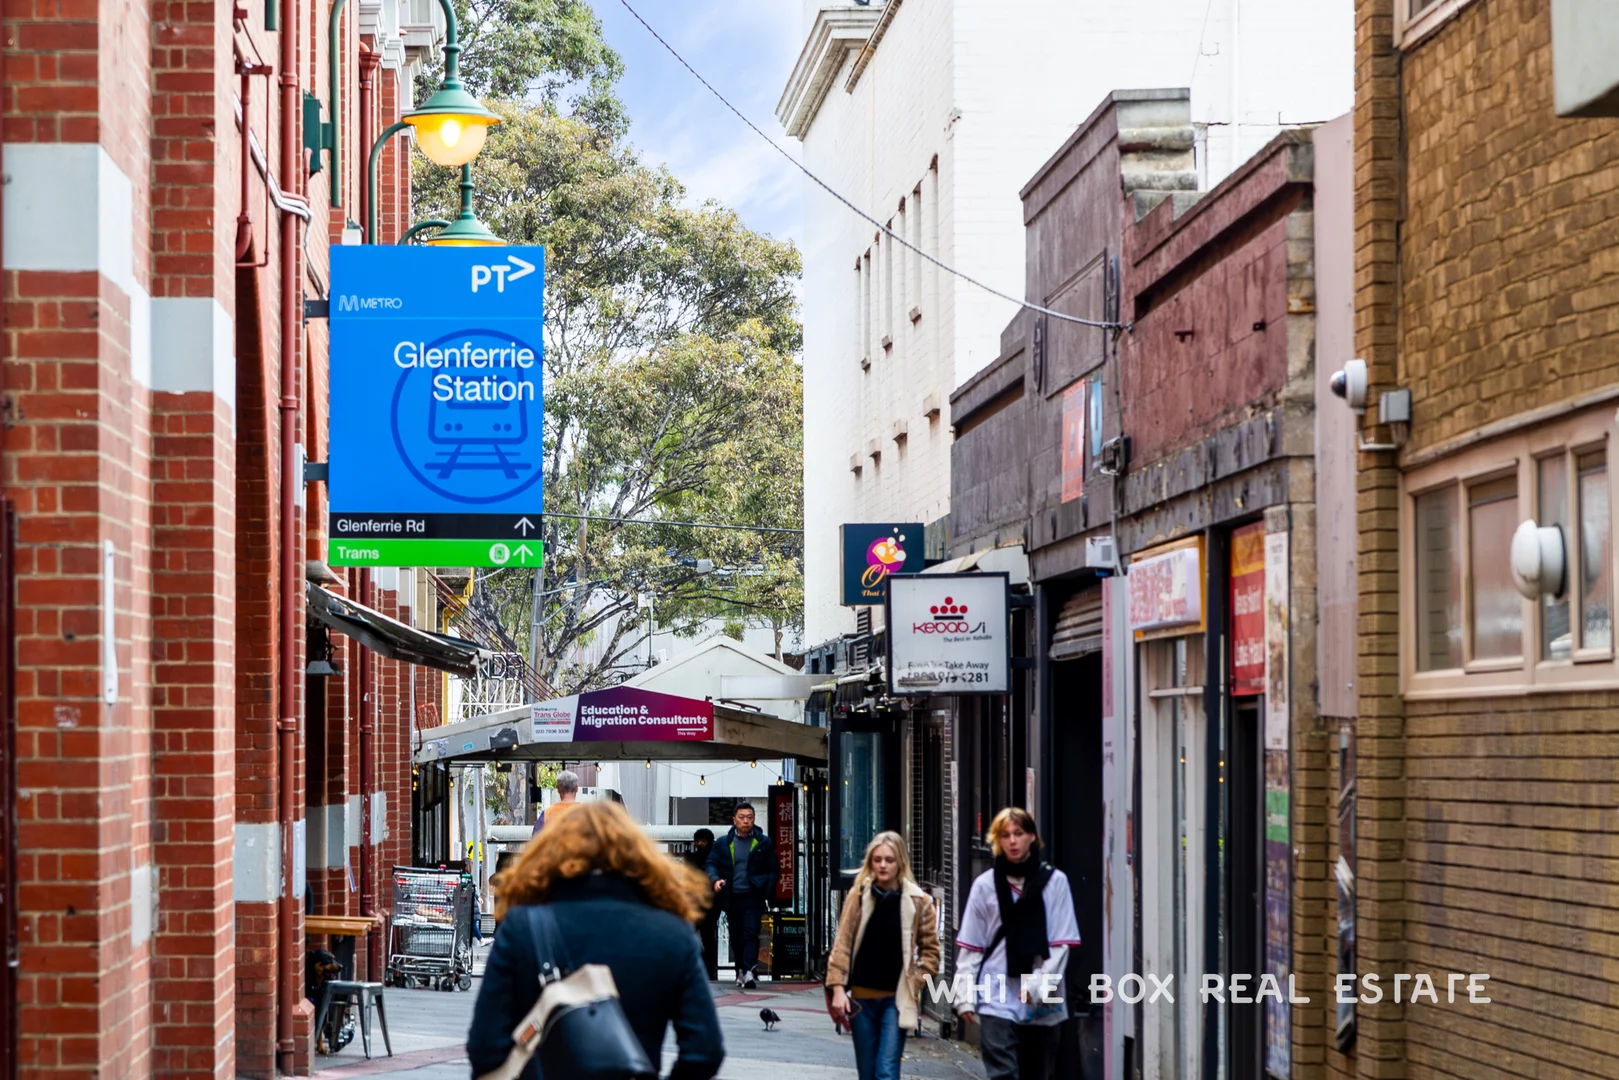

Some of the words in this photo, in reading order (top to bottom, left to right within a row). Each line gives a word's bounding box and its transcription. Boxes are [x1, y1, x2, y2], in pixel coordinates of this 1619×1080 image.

[360, 297, 403, 309] METRO
[394, 341, 534, 369] Glenferrie
[433, 374, 534, 401] Station
[337, 519, 402, 533] Glenferrie
[406, 519, 425, 533] Rd
[338, 547, 379, 560] Trams
[943, 661, 963, 669] Take
[965, 661, 989, 671] Away
[581, 704, 638, 716] Education
[639, 705, 649, 716] &
[581, 715, 637, 728] Migration
[638, 714, 708, 725] Consultants
